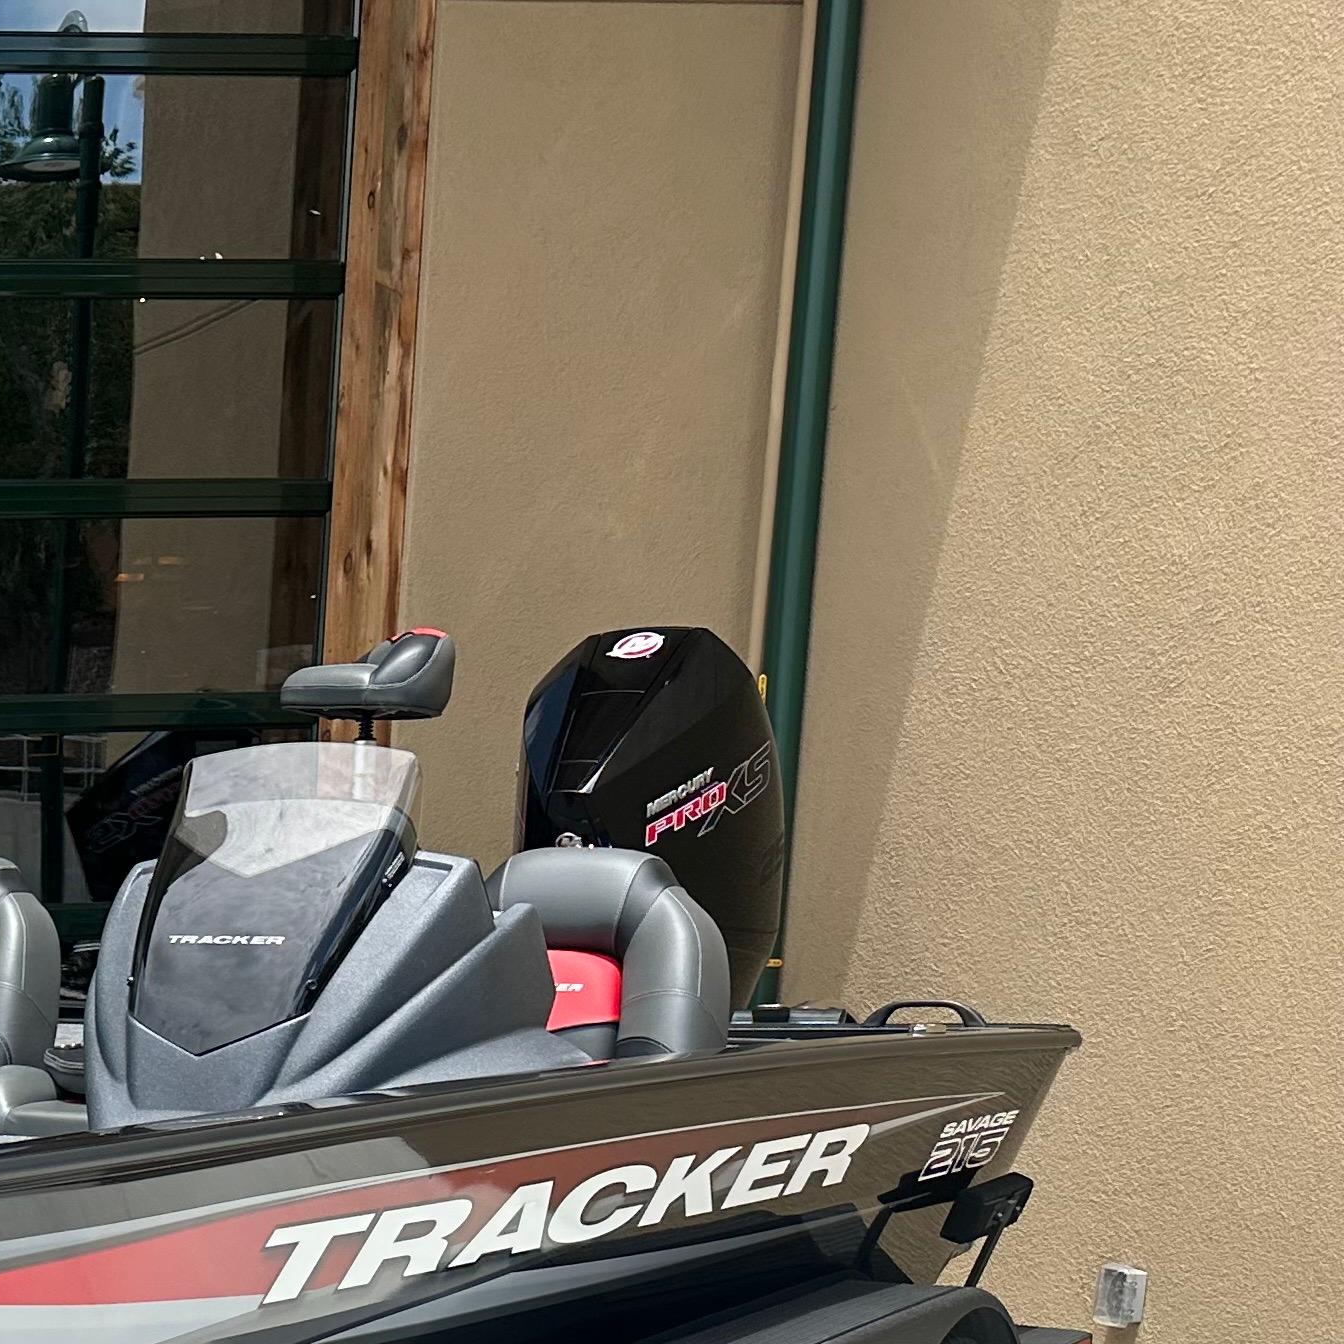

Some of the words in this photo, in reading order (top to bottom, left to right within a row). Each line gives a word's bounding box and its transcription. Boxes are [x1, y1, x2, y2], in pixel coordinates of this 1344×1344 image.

[645, 766, 715, 819] MERCURY
[645, 781, 727, 847] PRO
[168, 935, 286, 945] TRACKER
[940, 1109, 1020, 1139] SAVAGE
[918, 1126, 1010, 1182] 215
[260, 1123, 871, 1305] TRACKER
